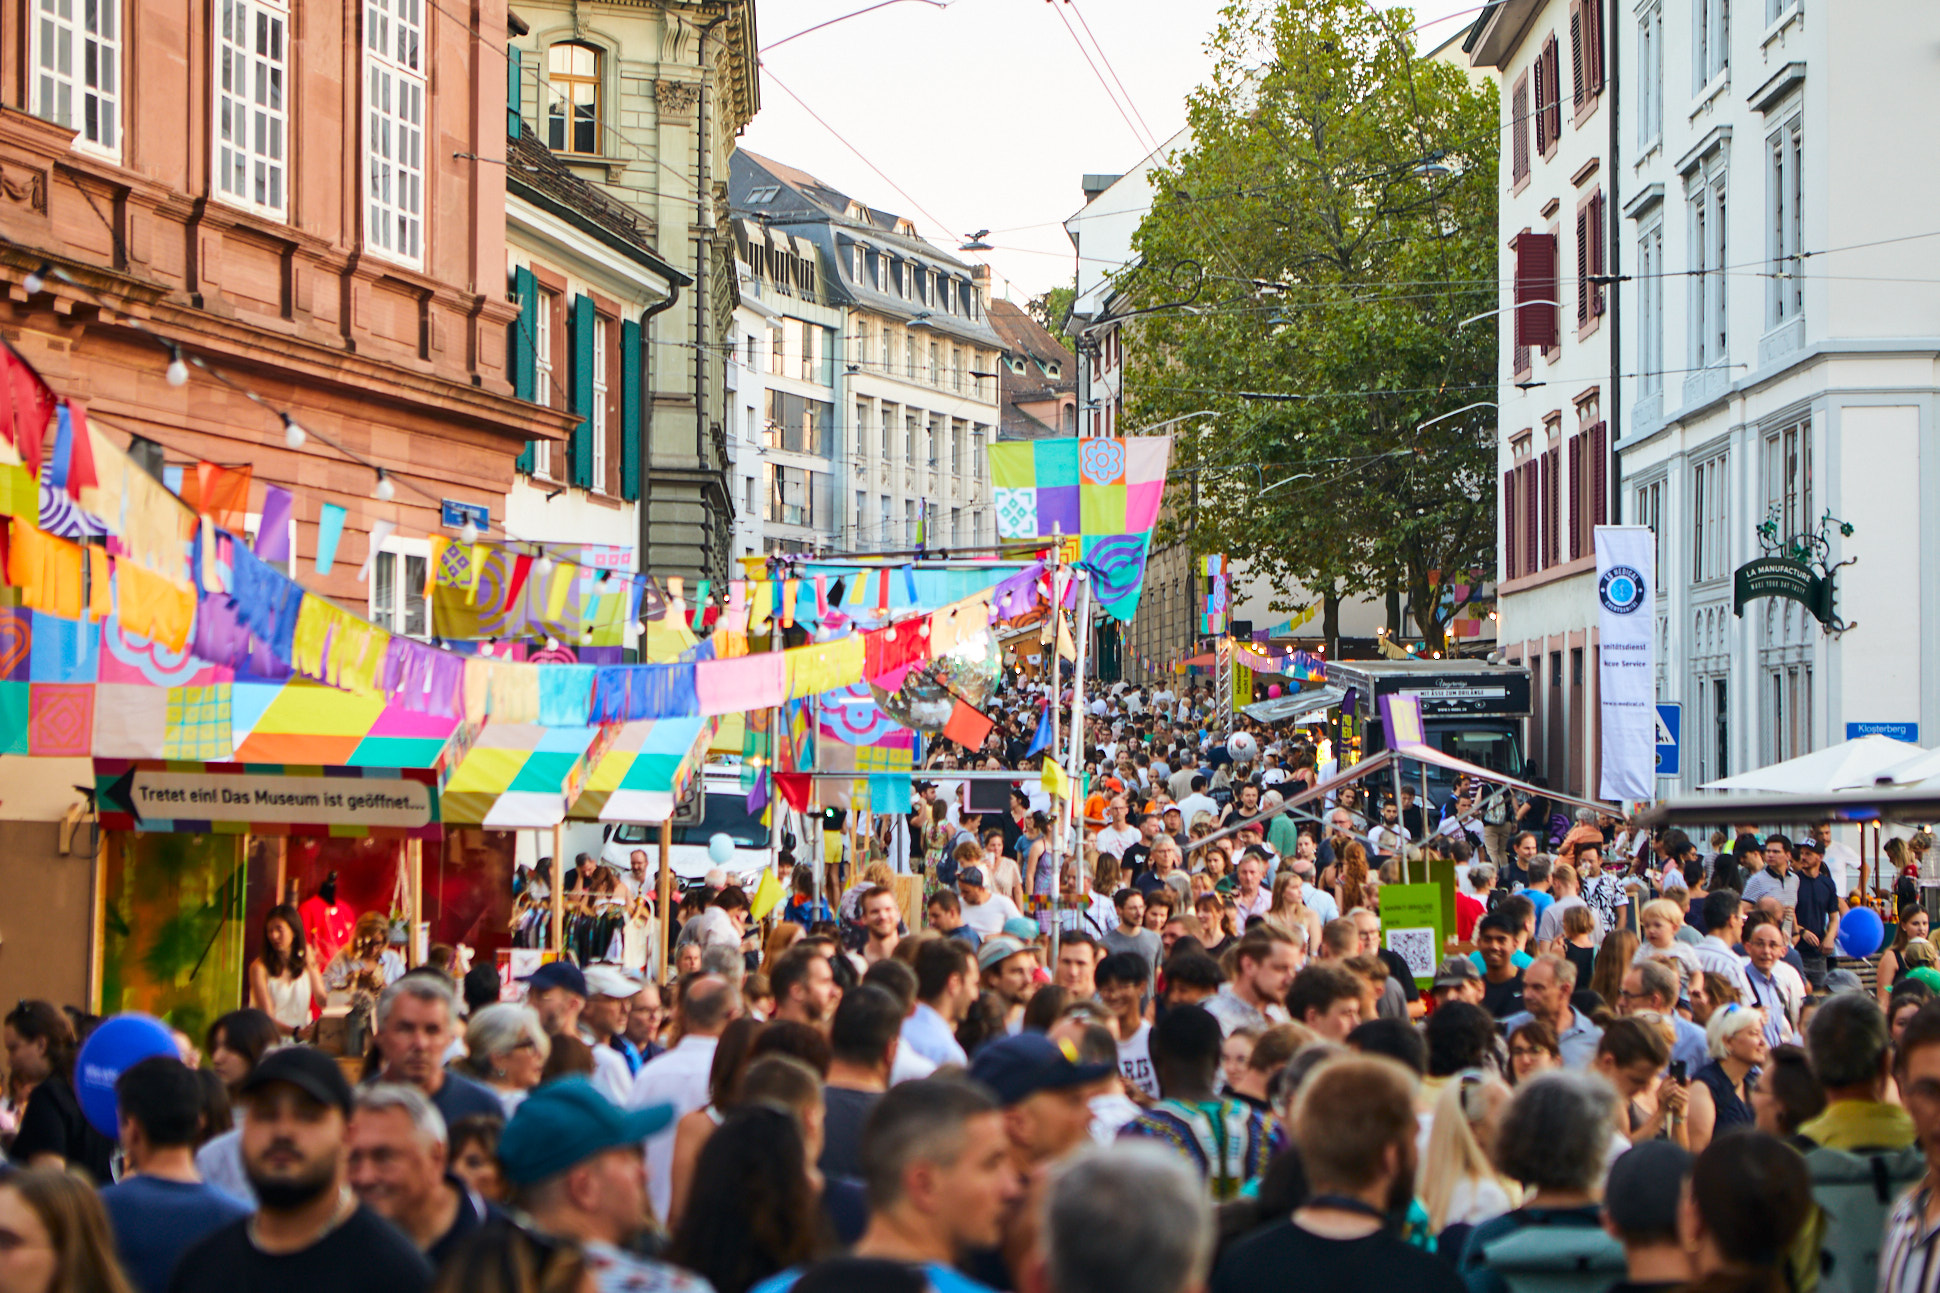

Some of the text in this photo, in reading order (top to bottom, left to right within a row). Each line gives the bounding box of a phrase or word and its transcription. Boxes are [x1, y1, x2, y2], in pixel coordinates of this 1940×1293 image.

[1613, 567, 1639, 581] MEDICAL
[1746, 565, 1812, 582] LA MANUFACTURE
[1858, 724, 1907, 735] Klosterberg
[139, 786, 187, 803] Tretet
[190, 788, 218, 804] ein!
[222, 789, 251, 805] Das
[254, 790, 320, 808] Museum
[324, 792, 345, 808] ist
